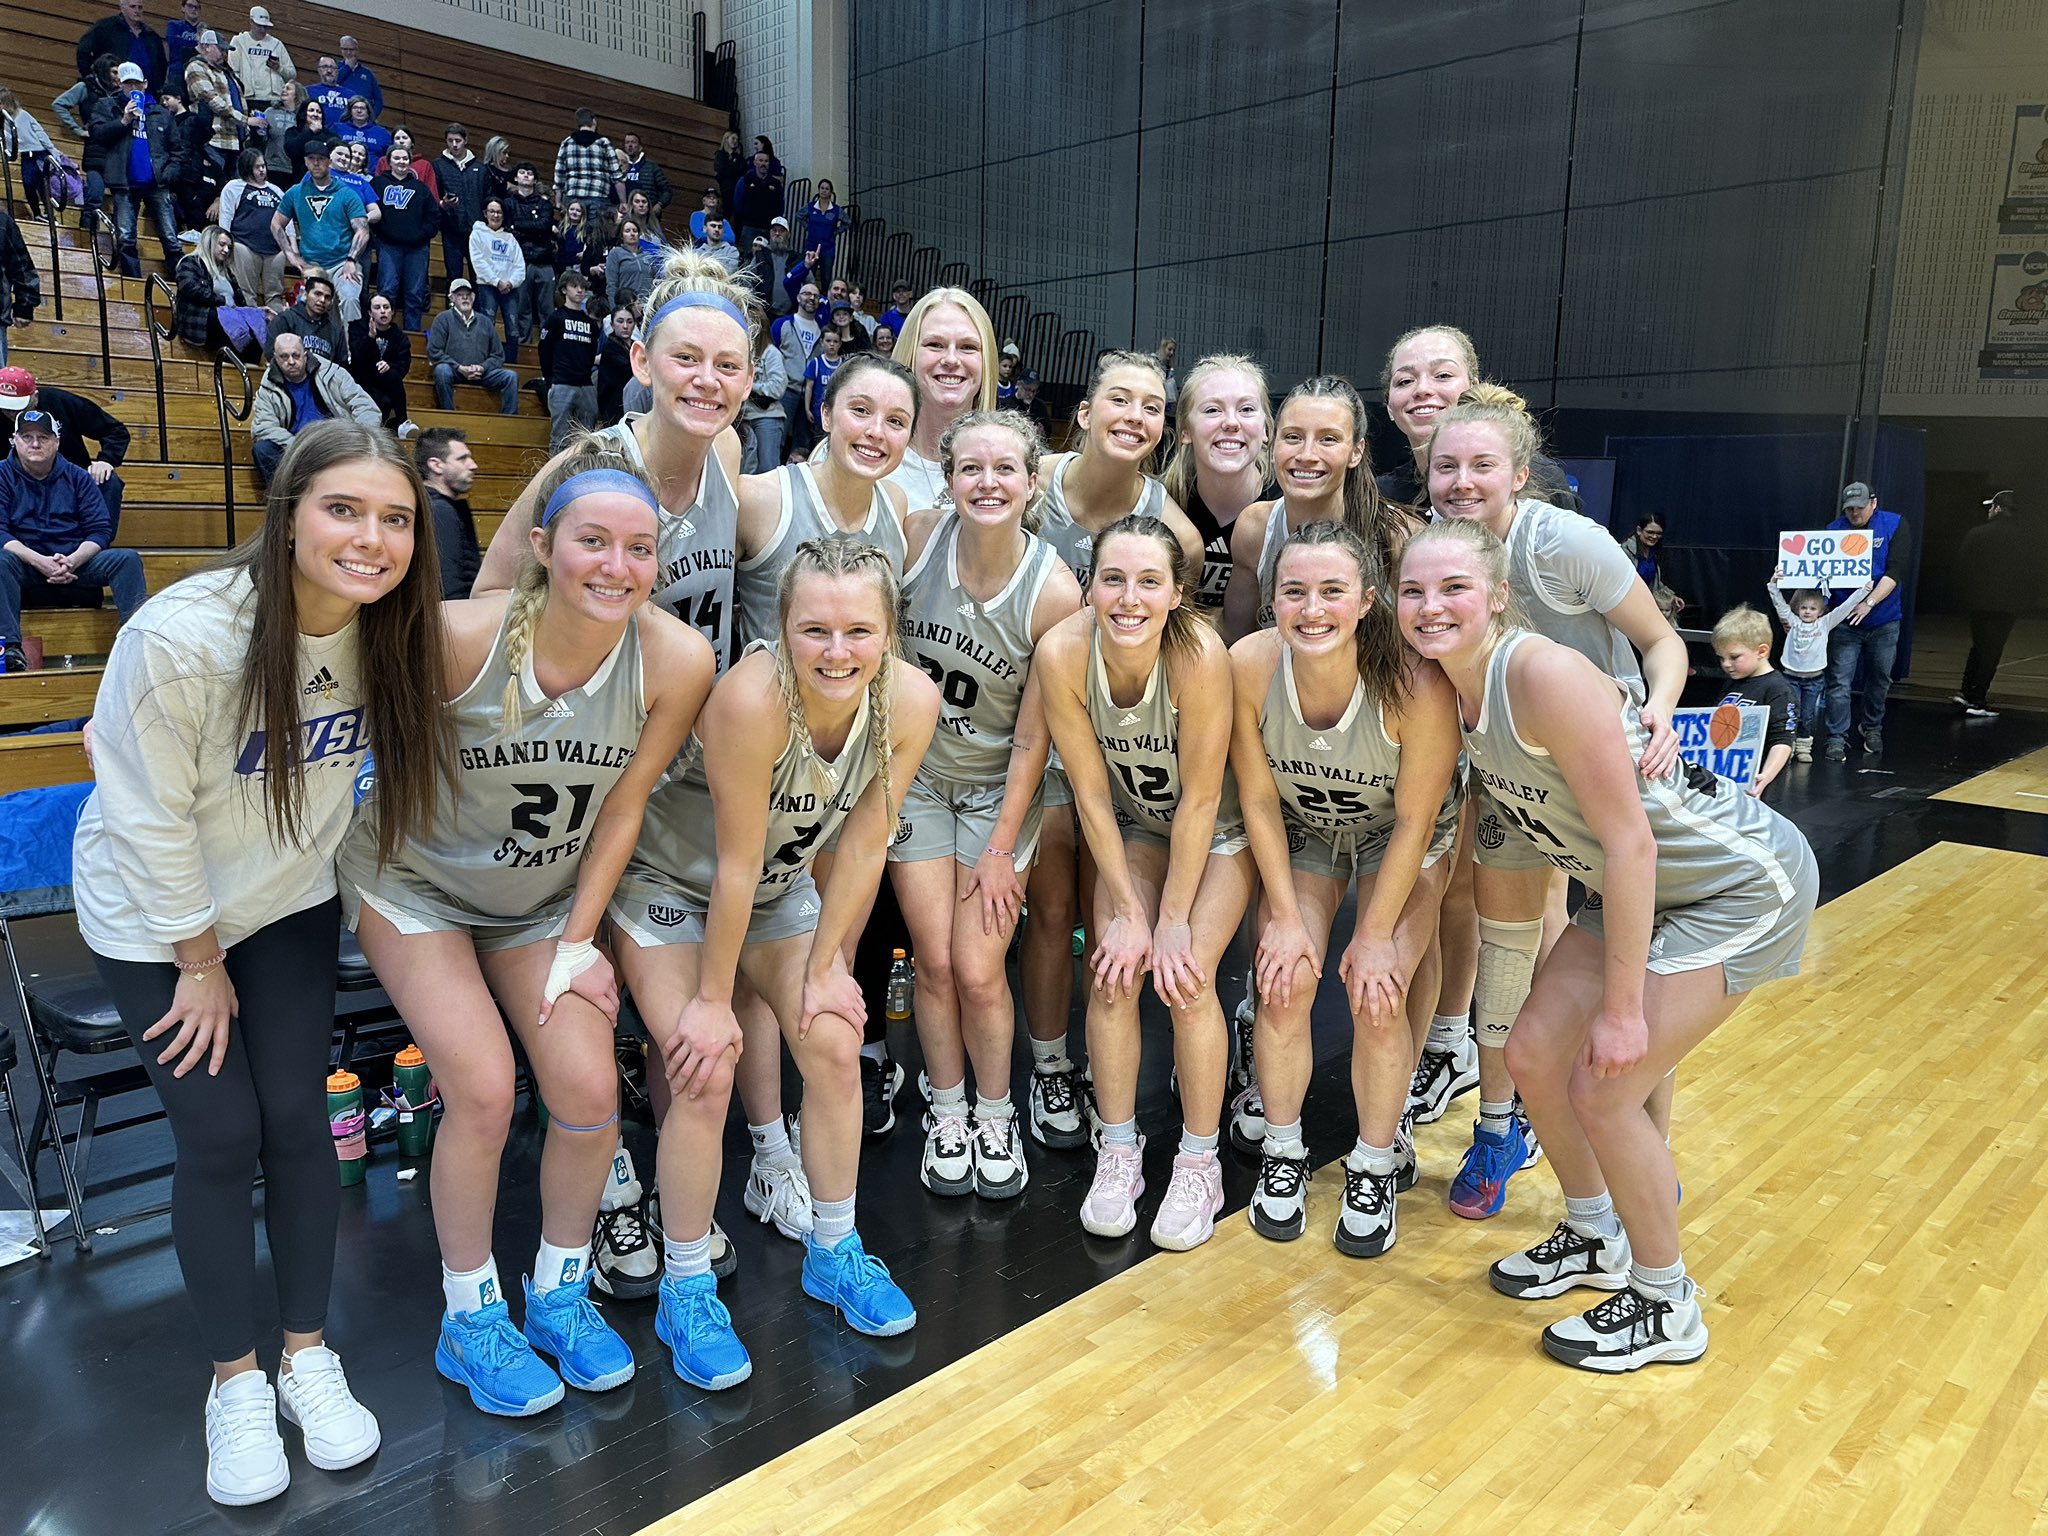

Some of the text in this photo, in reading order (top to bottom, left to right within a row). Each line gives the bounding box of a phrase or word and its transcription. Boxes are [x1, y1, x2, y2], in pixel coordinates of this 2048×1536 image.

[564, 319, 591, 334] GVSU
[1807, 537, 1836, 556] GO
[1782, 558, 1871, 577] LAKERS
[955, 632, 1018, 681] VALLEY
[459, 740, 549, 770] GRAND
[1111, 759, 1175, 803] 12
[510, 783, 595, 839] 21
[1291, 782, 1371, 815] 25
[1303, 811, 1380, 827] STATE
[492, 836, 581, 868] STATE
